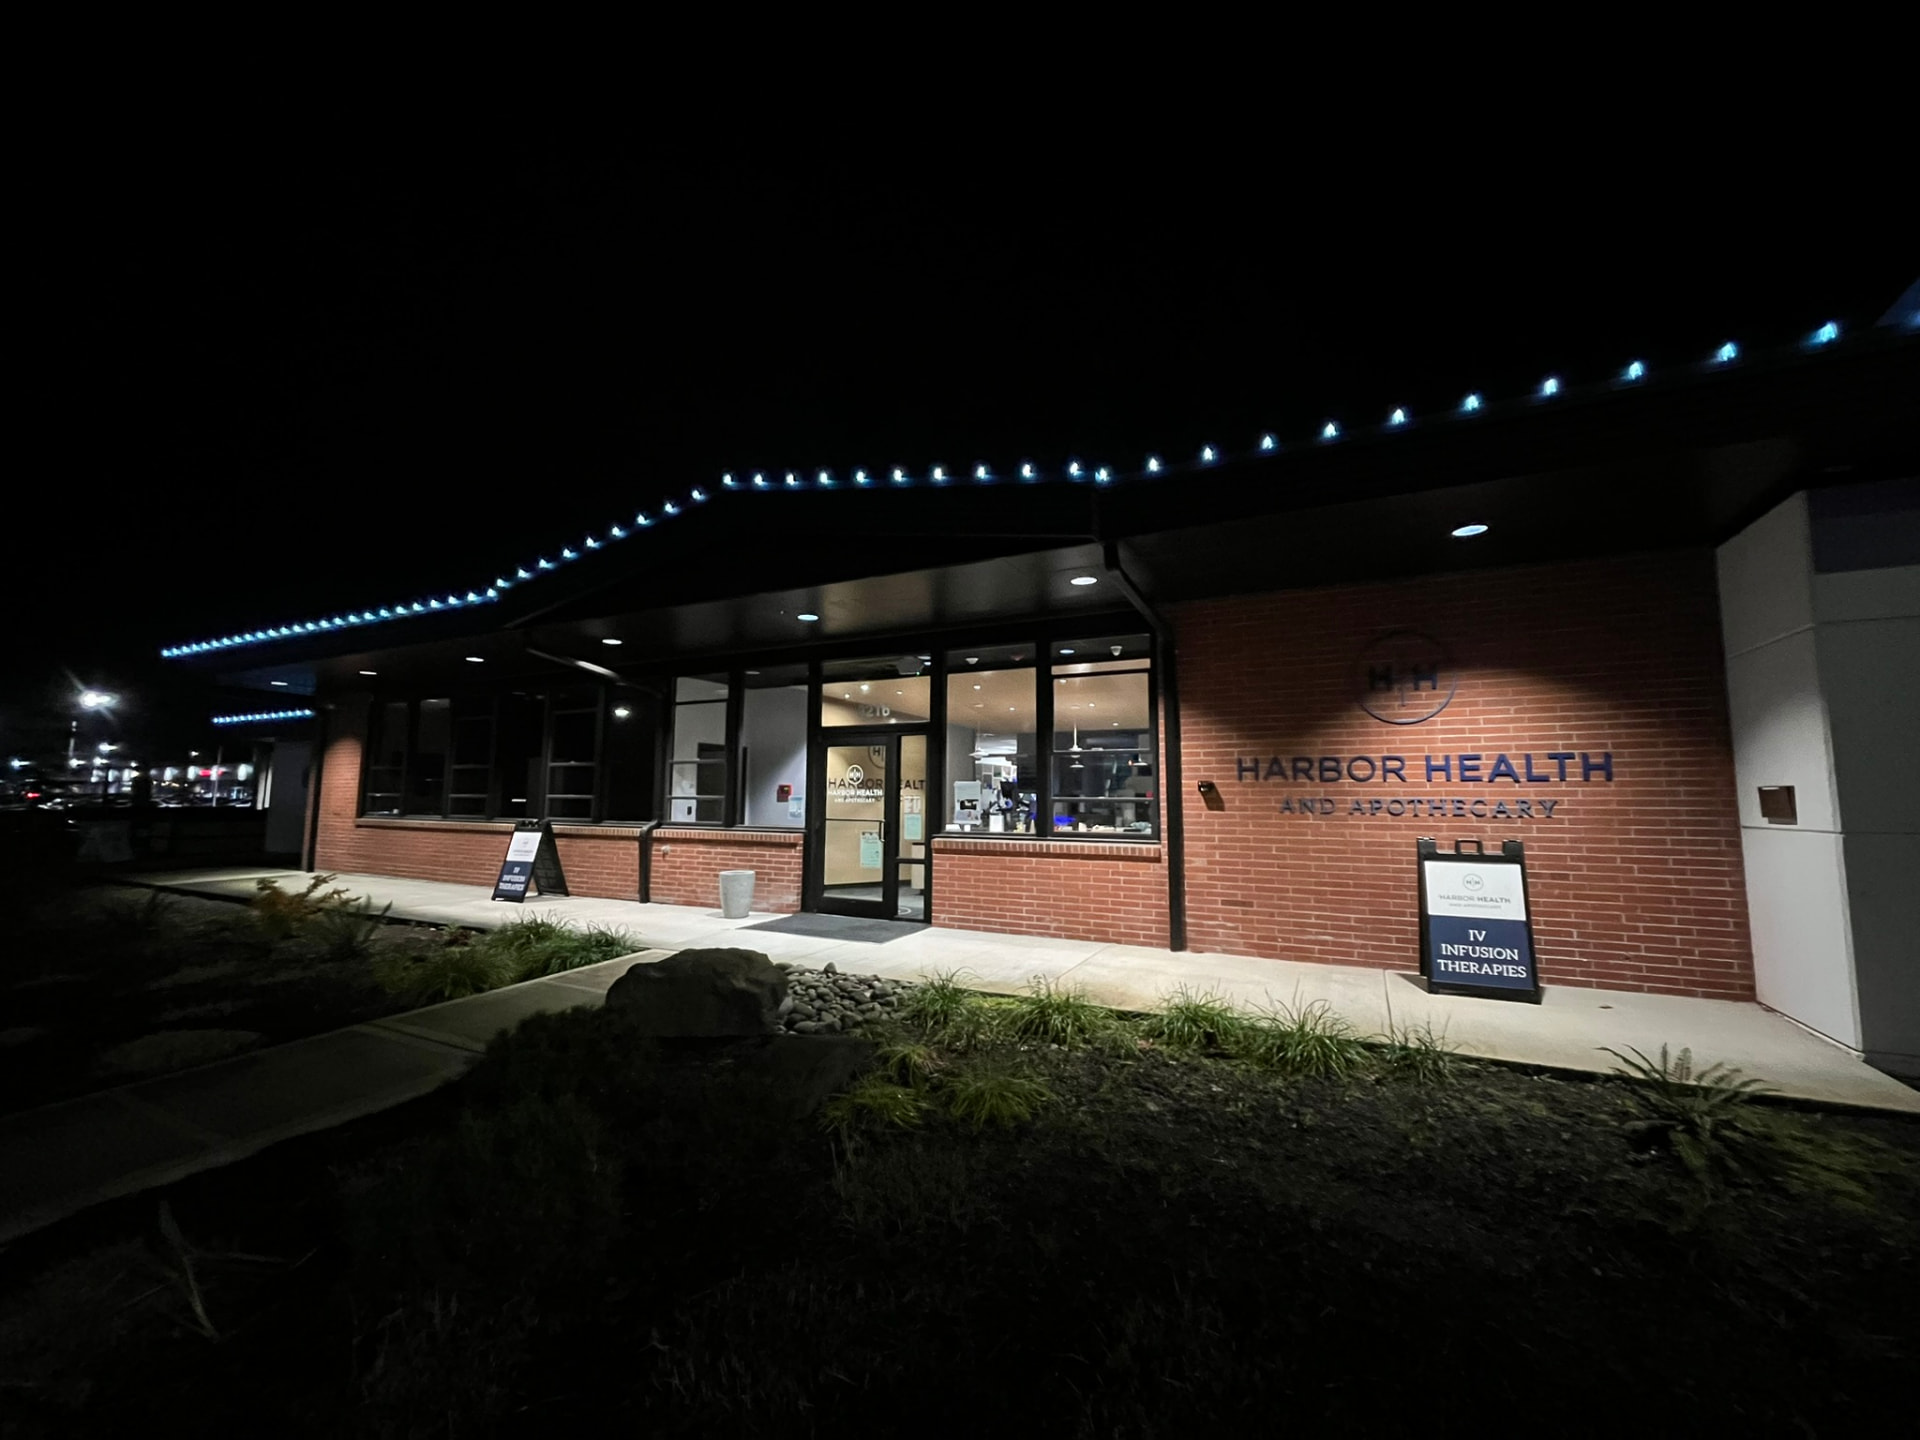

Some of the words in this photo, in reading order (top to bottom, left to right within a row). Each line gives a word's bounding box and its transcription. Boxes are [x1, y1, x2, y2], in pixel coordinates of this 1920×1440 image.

[1237, 755, 1407, 783] HARBOR
[1424, 752, 1613, 783] HEALTH
[1280, 797, 1336, 815] AND
[1348, 799, 1558, 818] APOTHECARY
[1439, 894, 1475, 902] HARBOR
[1477, 896, 1511, 904] HEALTH
[1468, 929, 1487, 942] IV
[1441, 943, 1519, 961] INFUSION
[1437, 959, 1527, 978] THERAPIES
